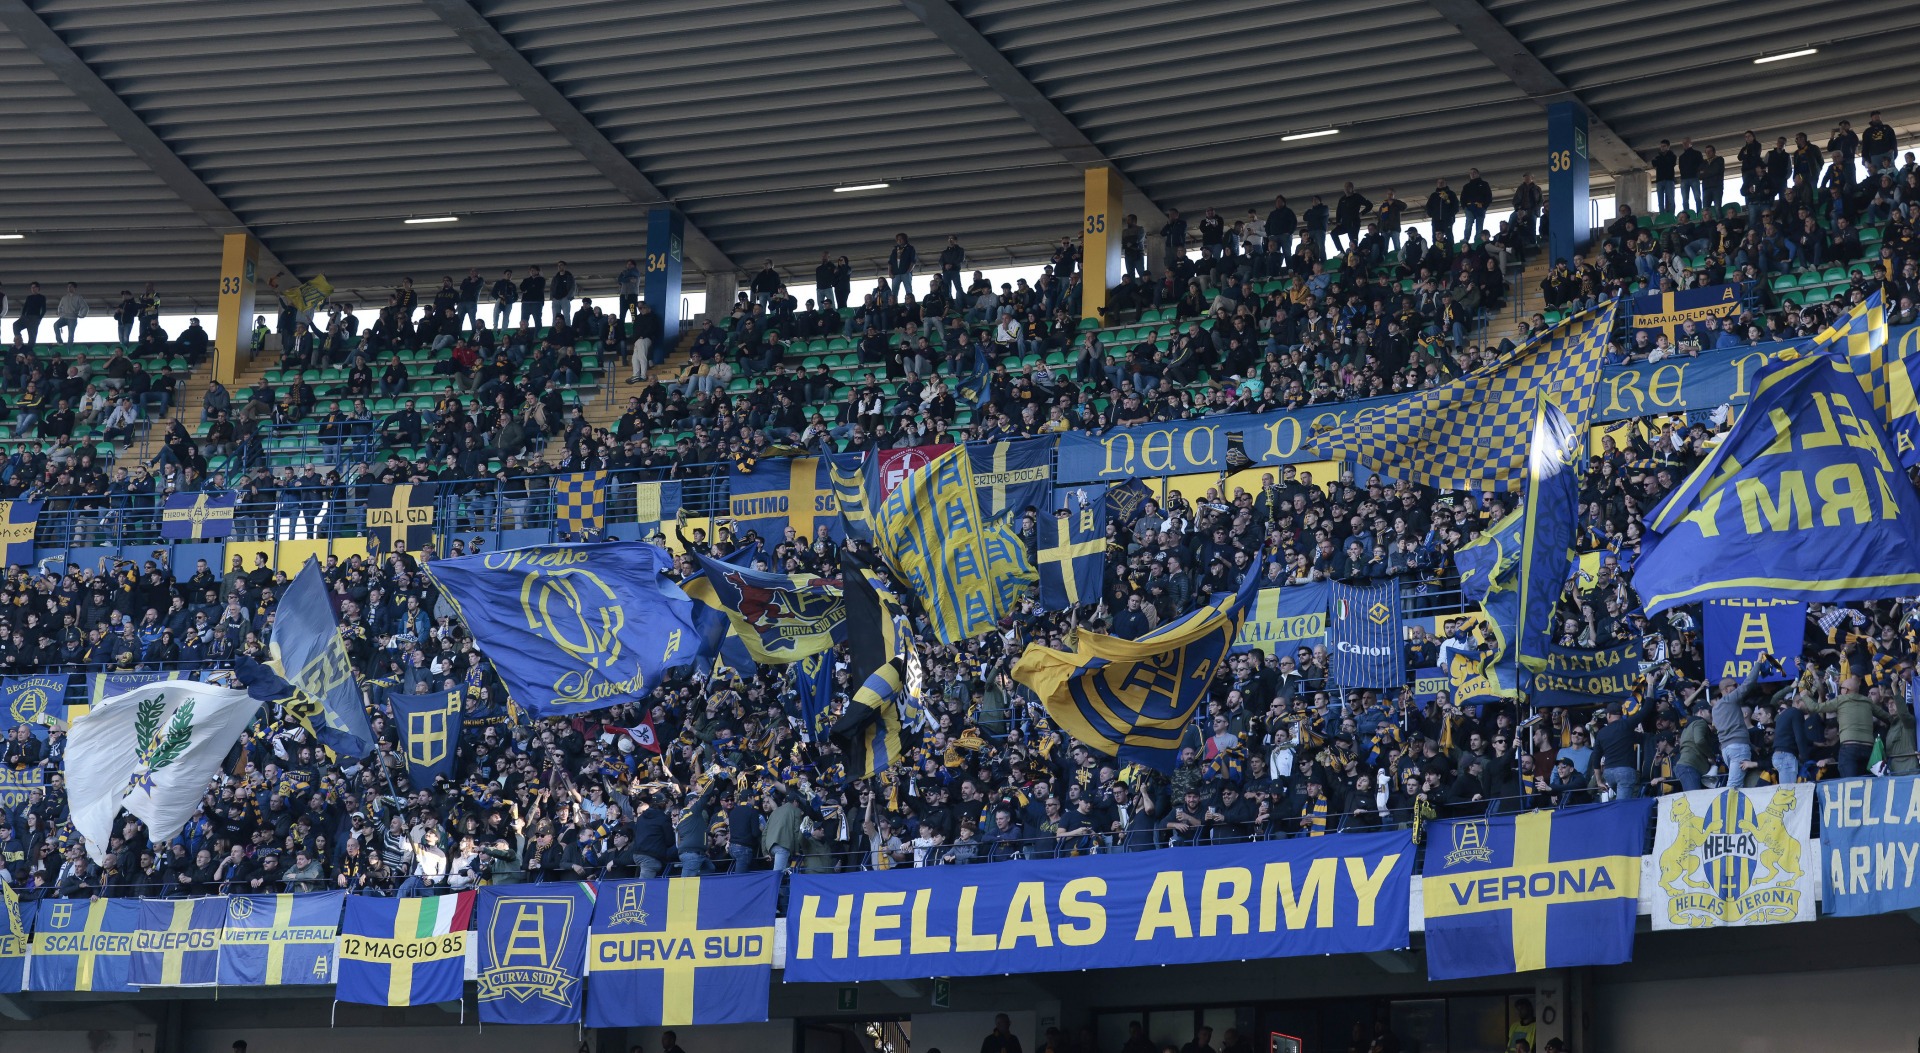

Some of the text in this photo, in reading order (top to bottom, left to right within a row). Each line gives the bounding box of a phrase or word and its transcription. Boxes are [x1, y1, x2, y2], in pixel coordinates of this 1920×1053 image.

[1550, 150, 1571, 172] 36
[1086, 214, 1105, 234] 35
[647, 252, 666, 272] 34
[221, 276, 241, 295] 33
[732, 495, 789, 517] ULTIMO
[780, 625, 813, 638] CURVA
[815, 619, 832, 634] SUD
[1337, 641, 1391, 657] Canon
[5, 678, 65, 695] BEGHELLAS
[1703, 832, 1757, 861] HELLAS
[1831, 841, 1920, 896] ARMY
[1449, 865, 1616, 906] VERONA
[796, 853, 1402, 960] HELLAS ARMY
[1675, 890, 1794, 917] HELLAS VERONA
[136, 931, 215, 950] QUEPOS
[225, 928, 334, 942] VIETTE LATERALI
[343, 936, 463, 959] 12 MAGGIO 85
[599, 934, 763, 963] CURVA SUD
[491, 970, 556, 986] CURVA SUD
